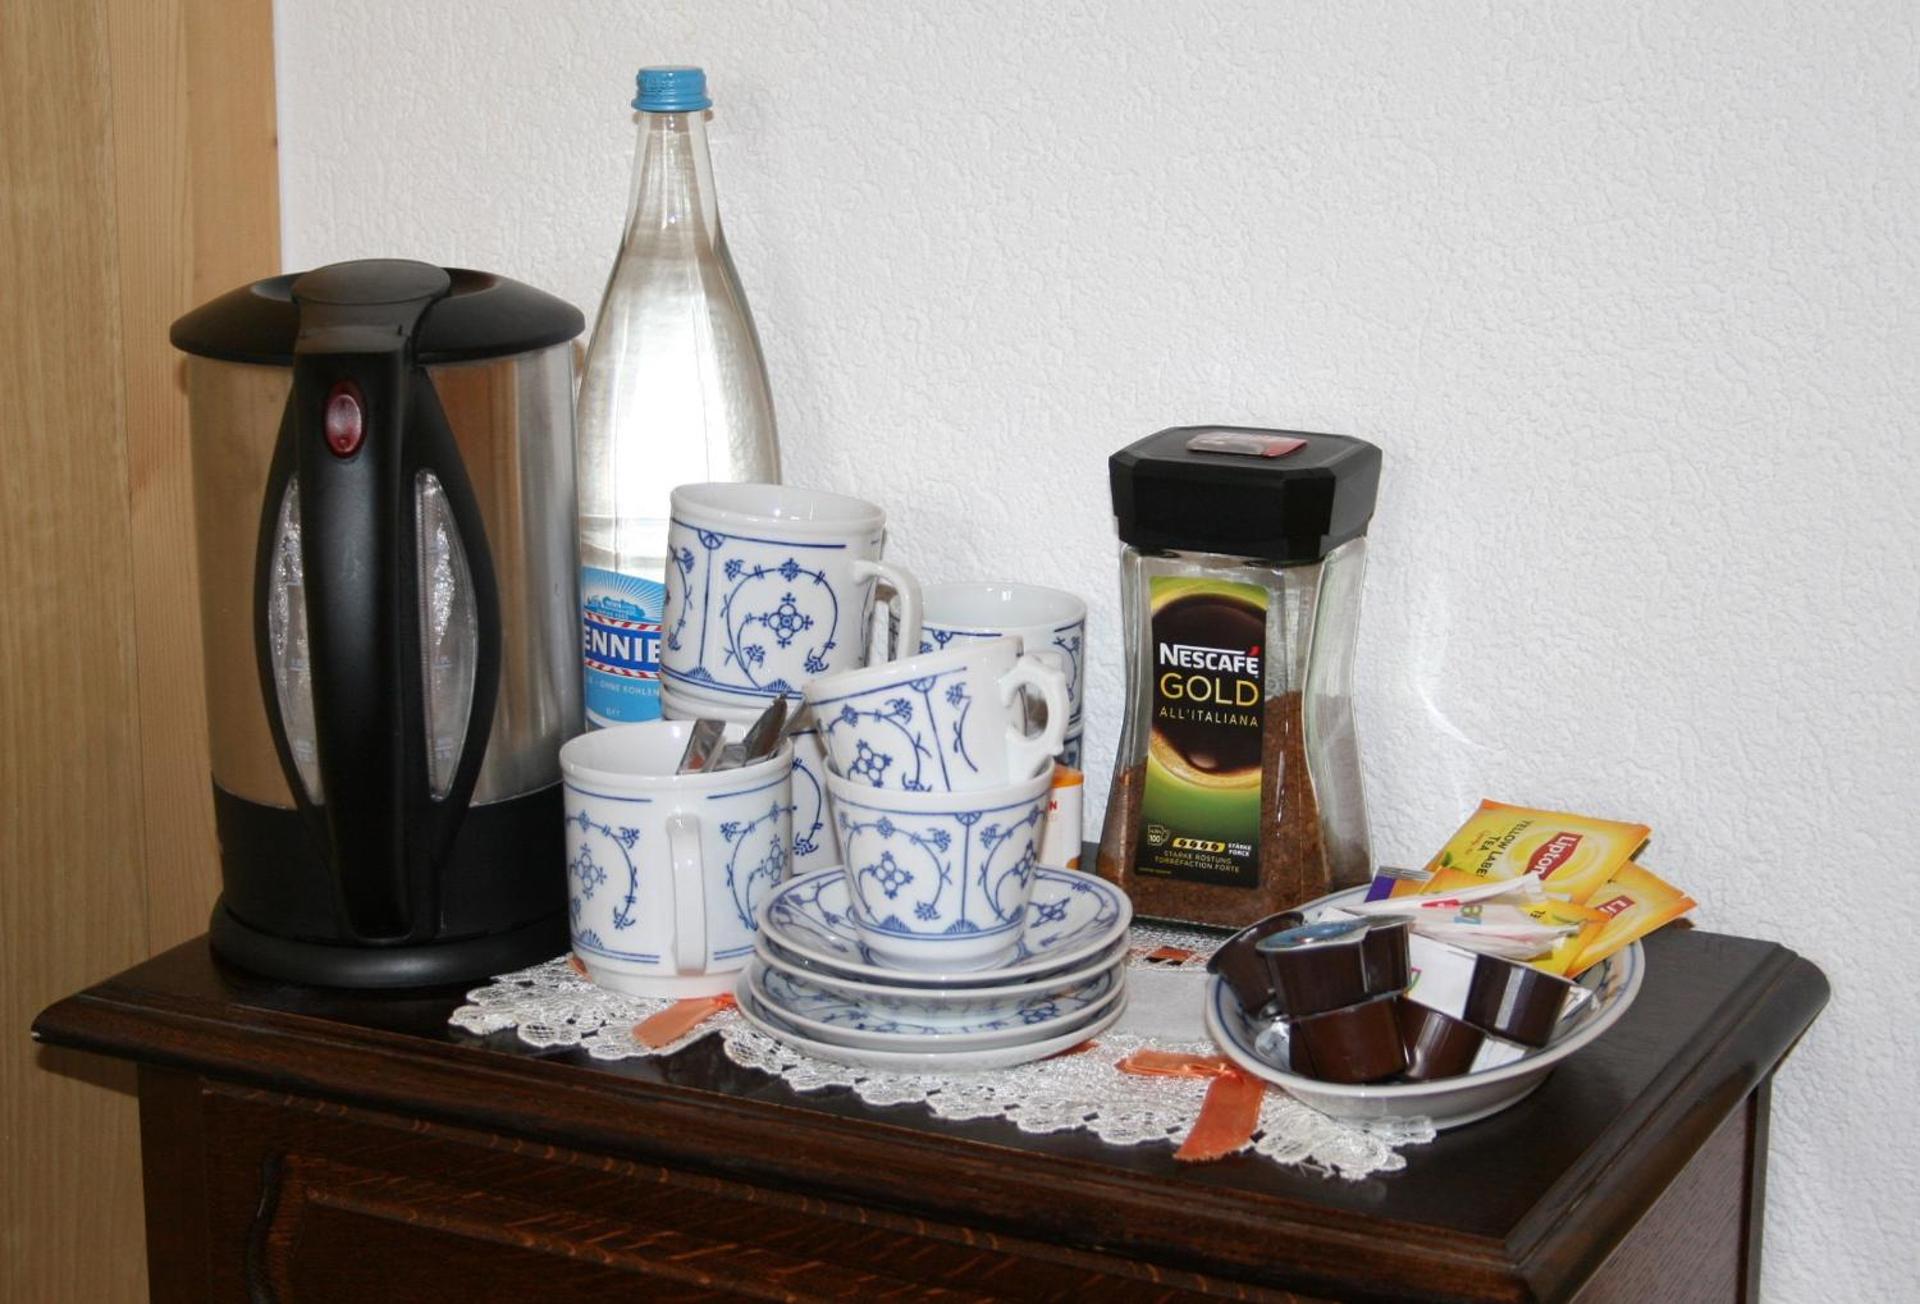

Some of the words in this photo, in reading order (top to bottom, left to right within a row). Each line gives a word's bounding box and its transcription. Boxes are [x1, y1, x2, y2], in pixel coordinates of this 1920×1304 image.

[1159, 642, 1261, 675] NESCAFÉ
[1160, 672, 1259, 706] GOLD
[1159, 705, 1259, 727] ALL'ITALIANA
[1477, 836, 1502, 851] TEA
[1498, 820, 1535, 850] YELLOW
[1534, 835, 1578, 876] Lipton
